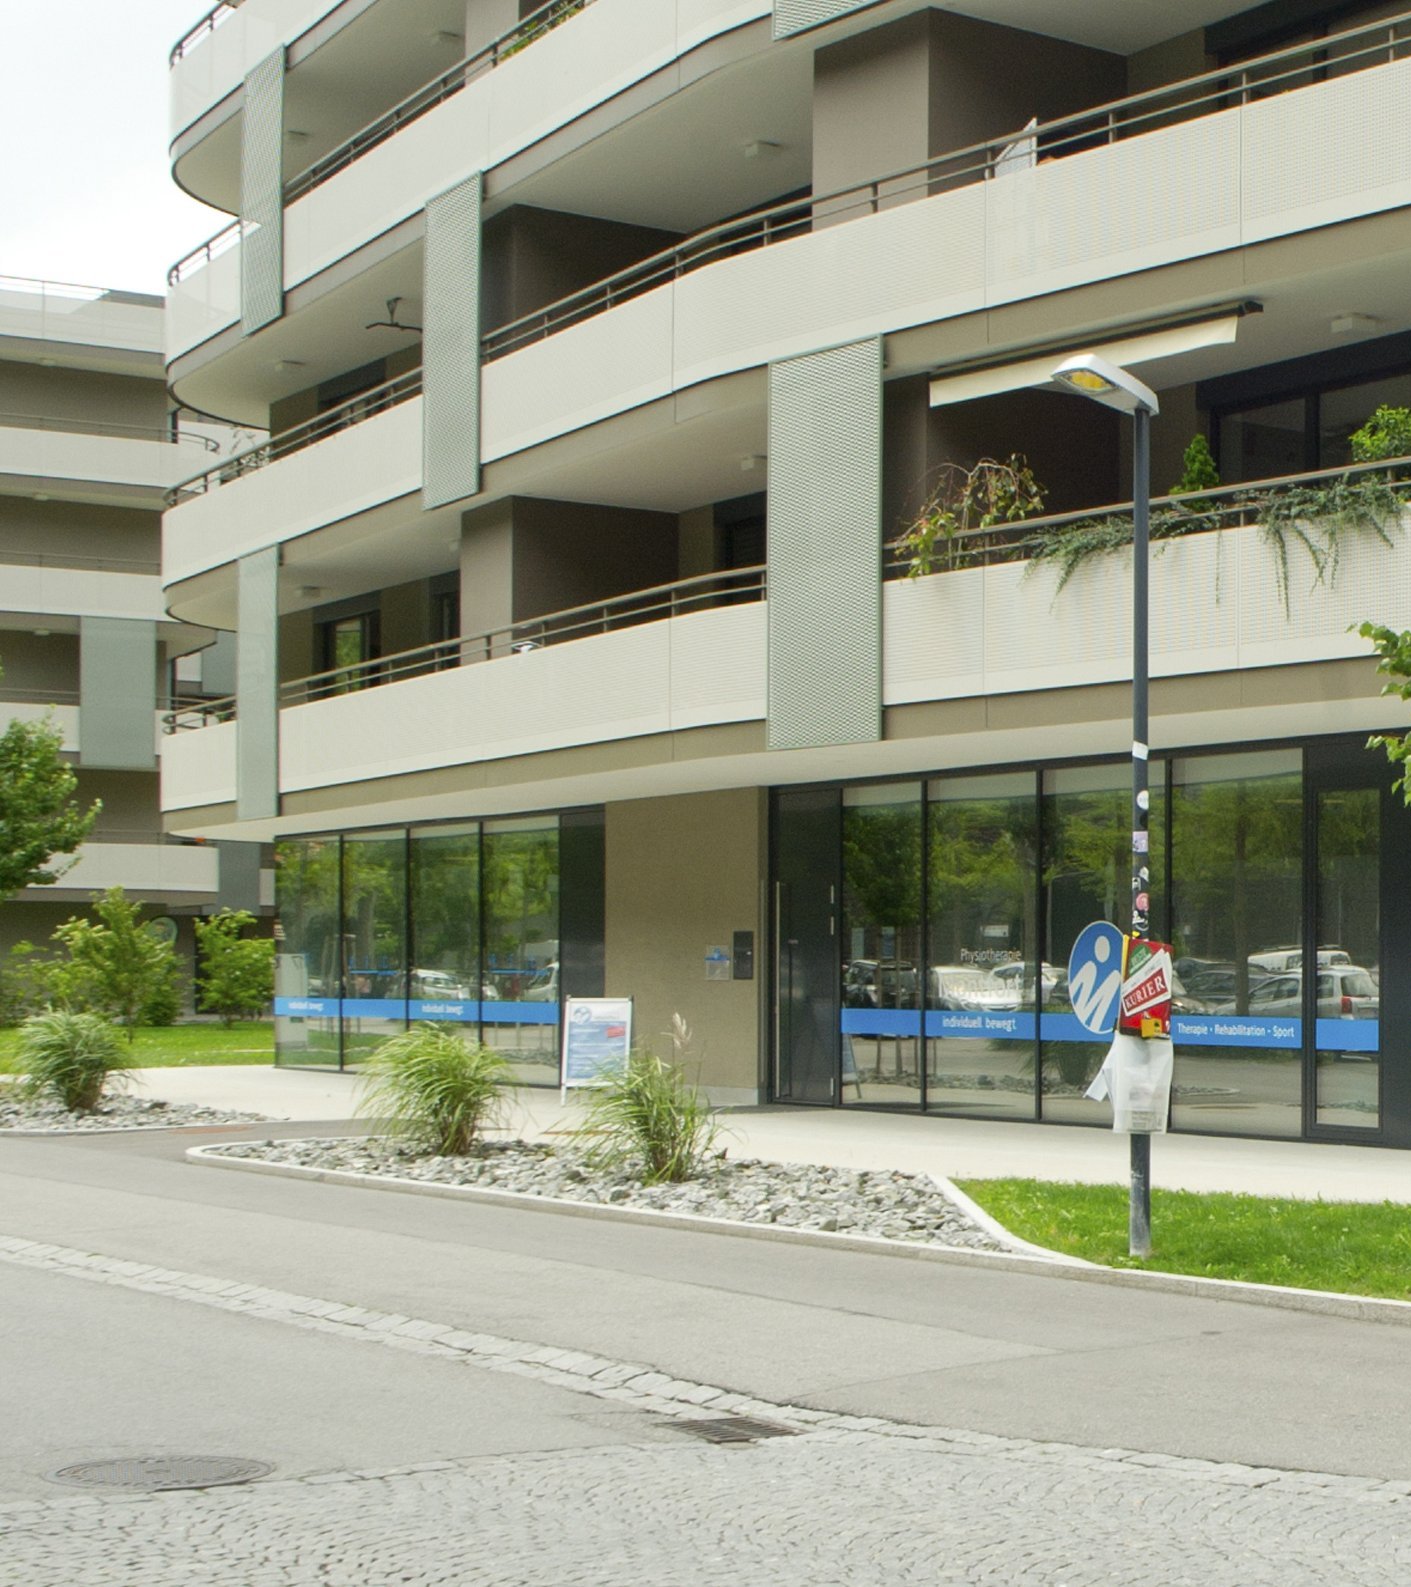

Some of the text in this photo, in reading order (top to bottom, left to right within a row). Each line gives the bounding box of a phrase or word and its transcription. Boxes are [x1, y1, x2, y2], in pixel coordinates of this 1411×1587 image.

[960, 946, 1021, 964] Physiotherapie
[1124, 975, 1166, 1009] KURIER
[942, 1015, 1017, 1032] individuell bewegt
[1177, 1022, 1294, 1039] Therapie Rehabilitation Sport
